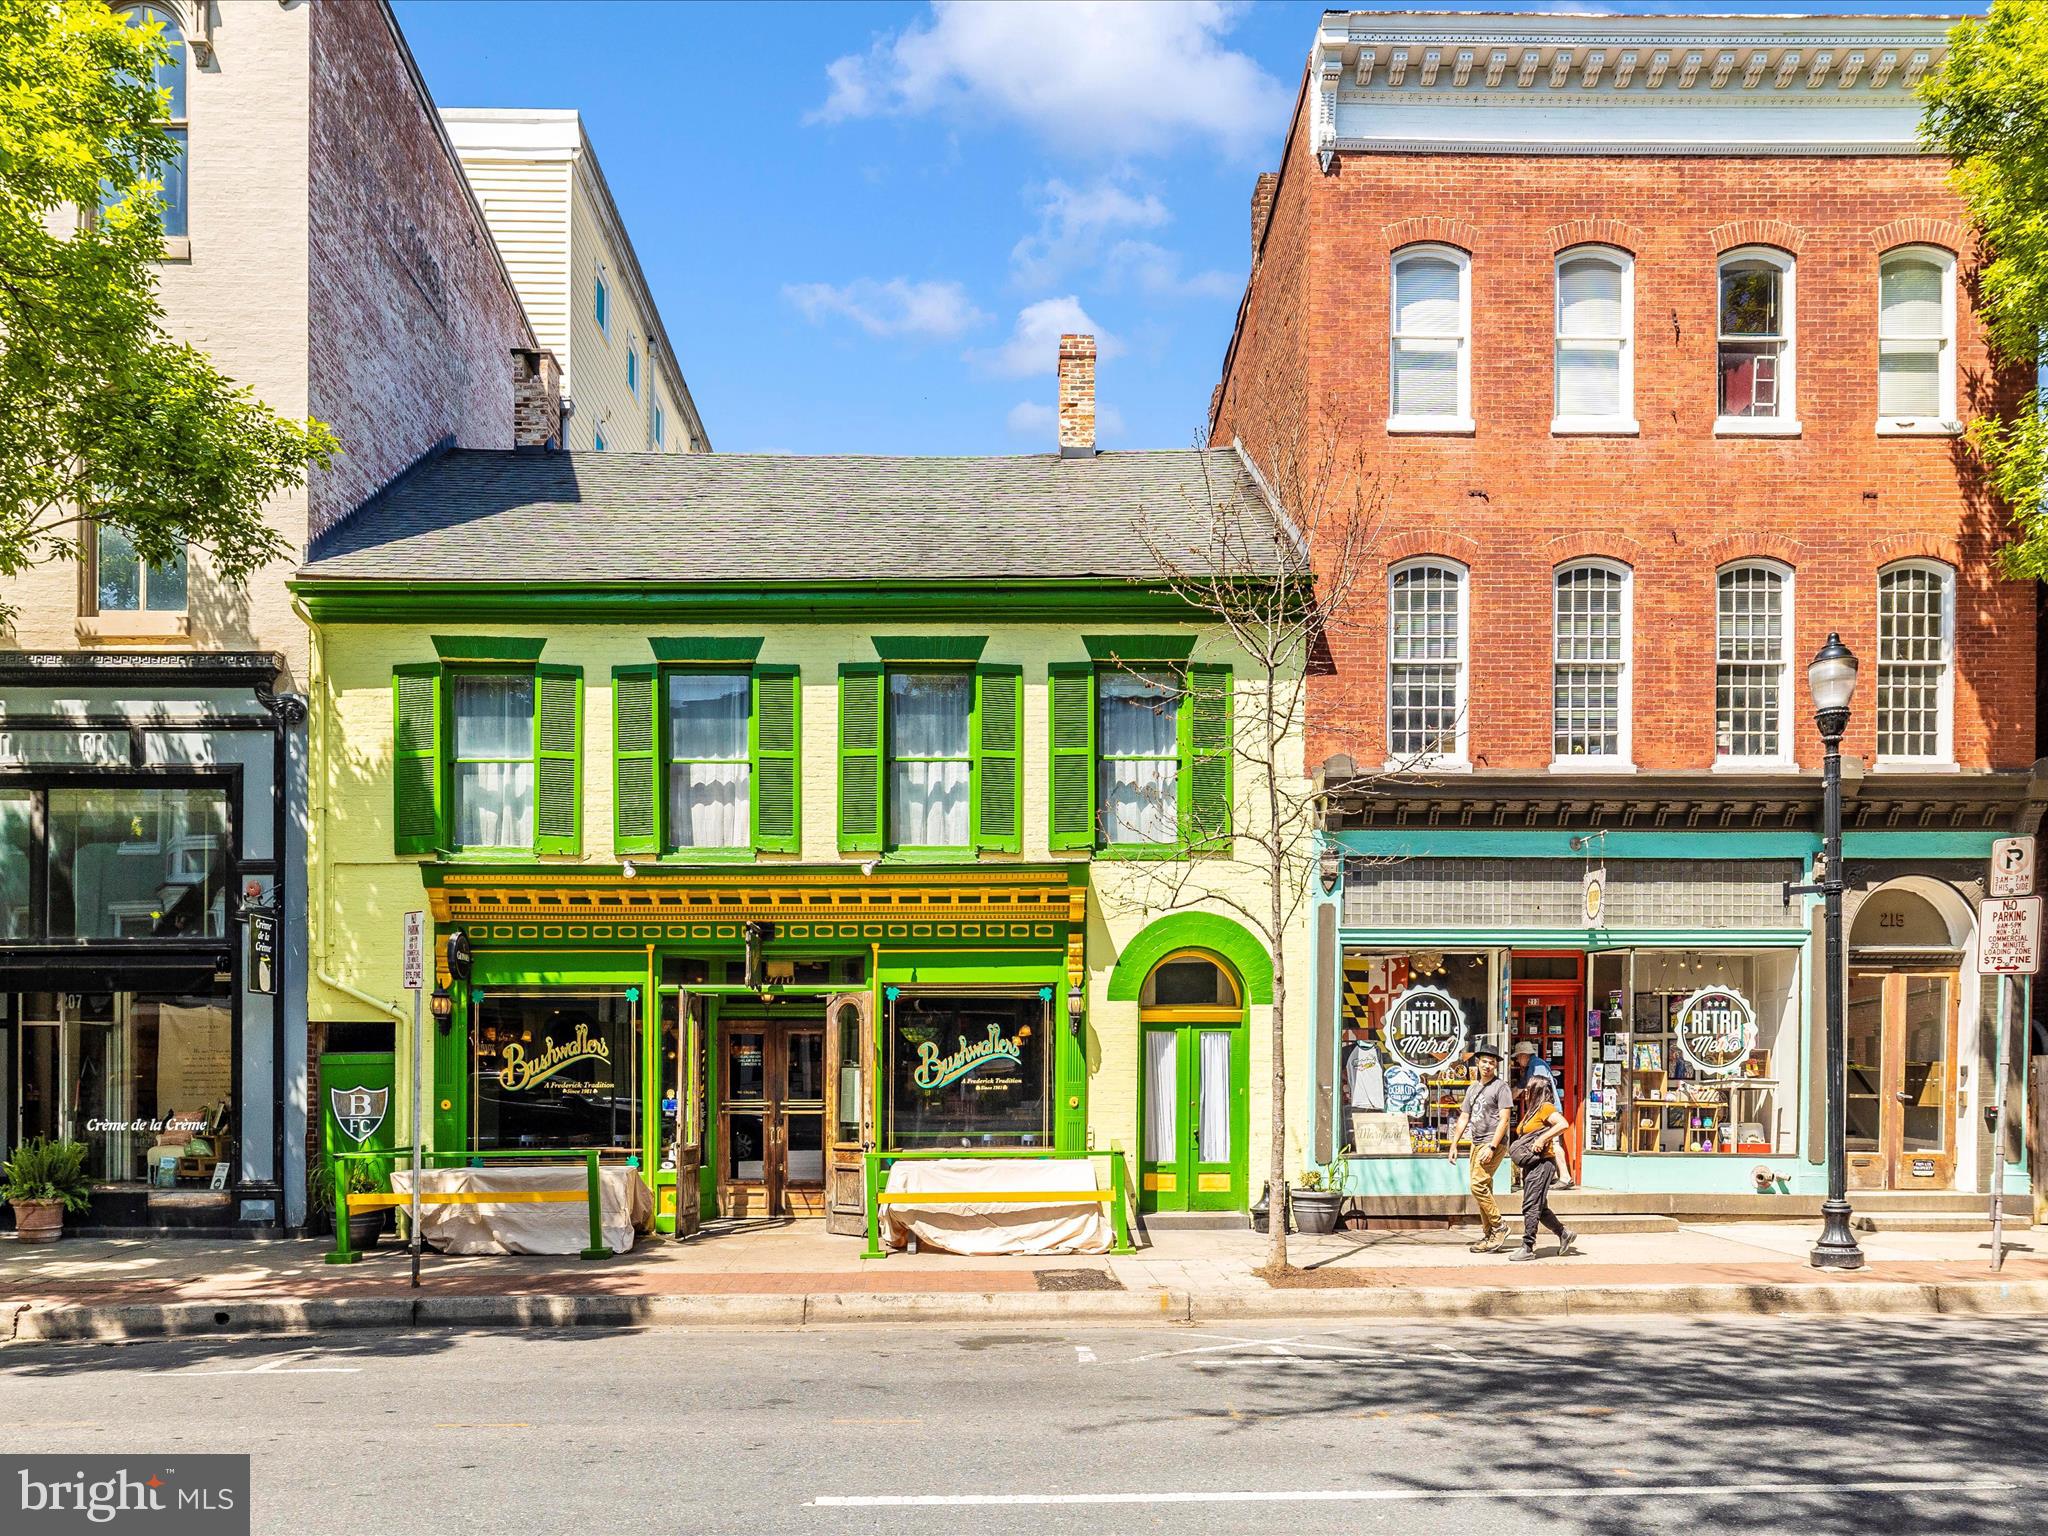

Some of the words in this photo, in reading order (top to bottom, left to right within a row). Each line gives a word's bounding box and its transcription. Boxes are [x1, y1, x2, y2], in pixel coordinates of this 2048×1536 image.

[1995, 884, 2009, 892] THIS
[2015, 882, 2029, 891] SIDE
[2002, 900, 2018, 911] NO
[1880, 912, 1905, 928] 215
[1992, 910, 2027, 922] PARKING
[255, 919, 273, 931] Crème
[257, 930, 265, 940] de
[264, 932, 270, 941] la
[255, 941, 273, 954] Crème
[2014, 947, 2032, 955] ZONE
[2009, 955, 2031, 963] FINE
[1400, 1010, 1451, 1035] RETRO
[1691, 1010, 1742, 1035] RETRO
[1400, 1036, 1451, 1058] Metro
[543, 1081, 550, 1089] A
[550, 1081, 583, 1089] Frederick
[583, 1081, 615, 1089] Tradition
[349, 1094, 372, 1116] B
[86, 1118, 128, 1132] Crème
[131, 1118, 147, 1131] de
[149, 1118, 162, 1131] la
[165, 1118, 208, 1132] Crème
[349, 1118, 371, 1134] FC
